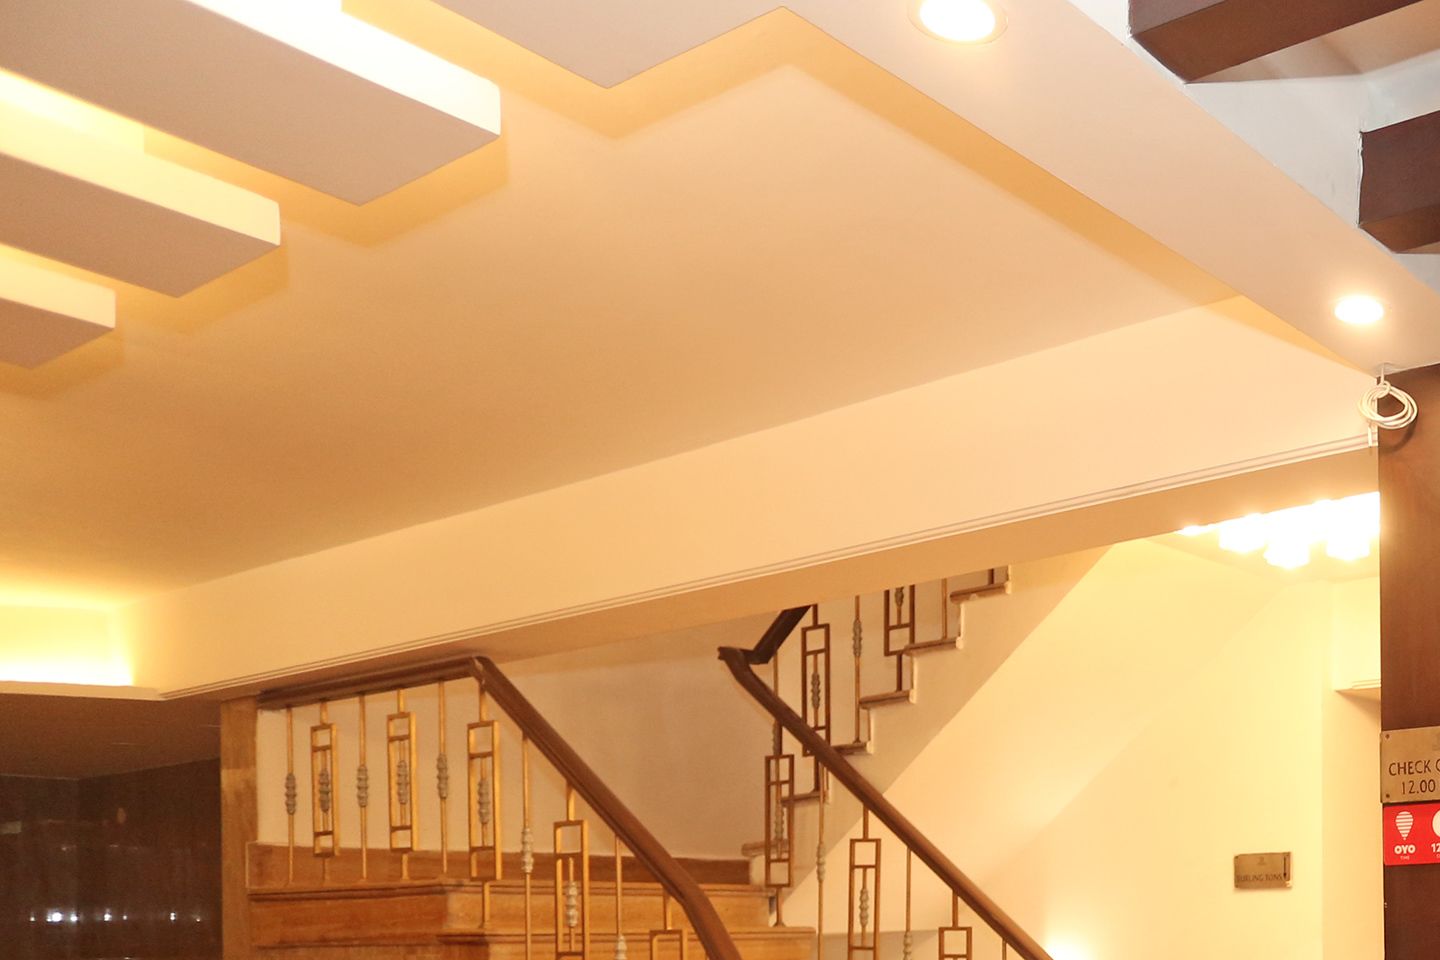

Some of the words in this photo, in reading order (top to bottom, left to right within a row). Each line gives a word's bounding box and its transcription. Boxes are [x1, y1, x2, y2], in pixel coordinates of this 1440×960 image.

[1388, 759, 1431, 776] CHECK
[1401, 779, 1436, 795] 12.00
[1394, 844, 1416, 855] OYO
